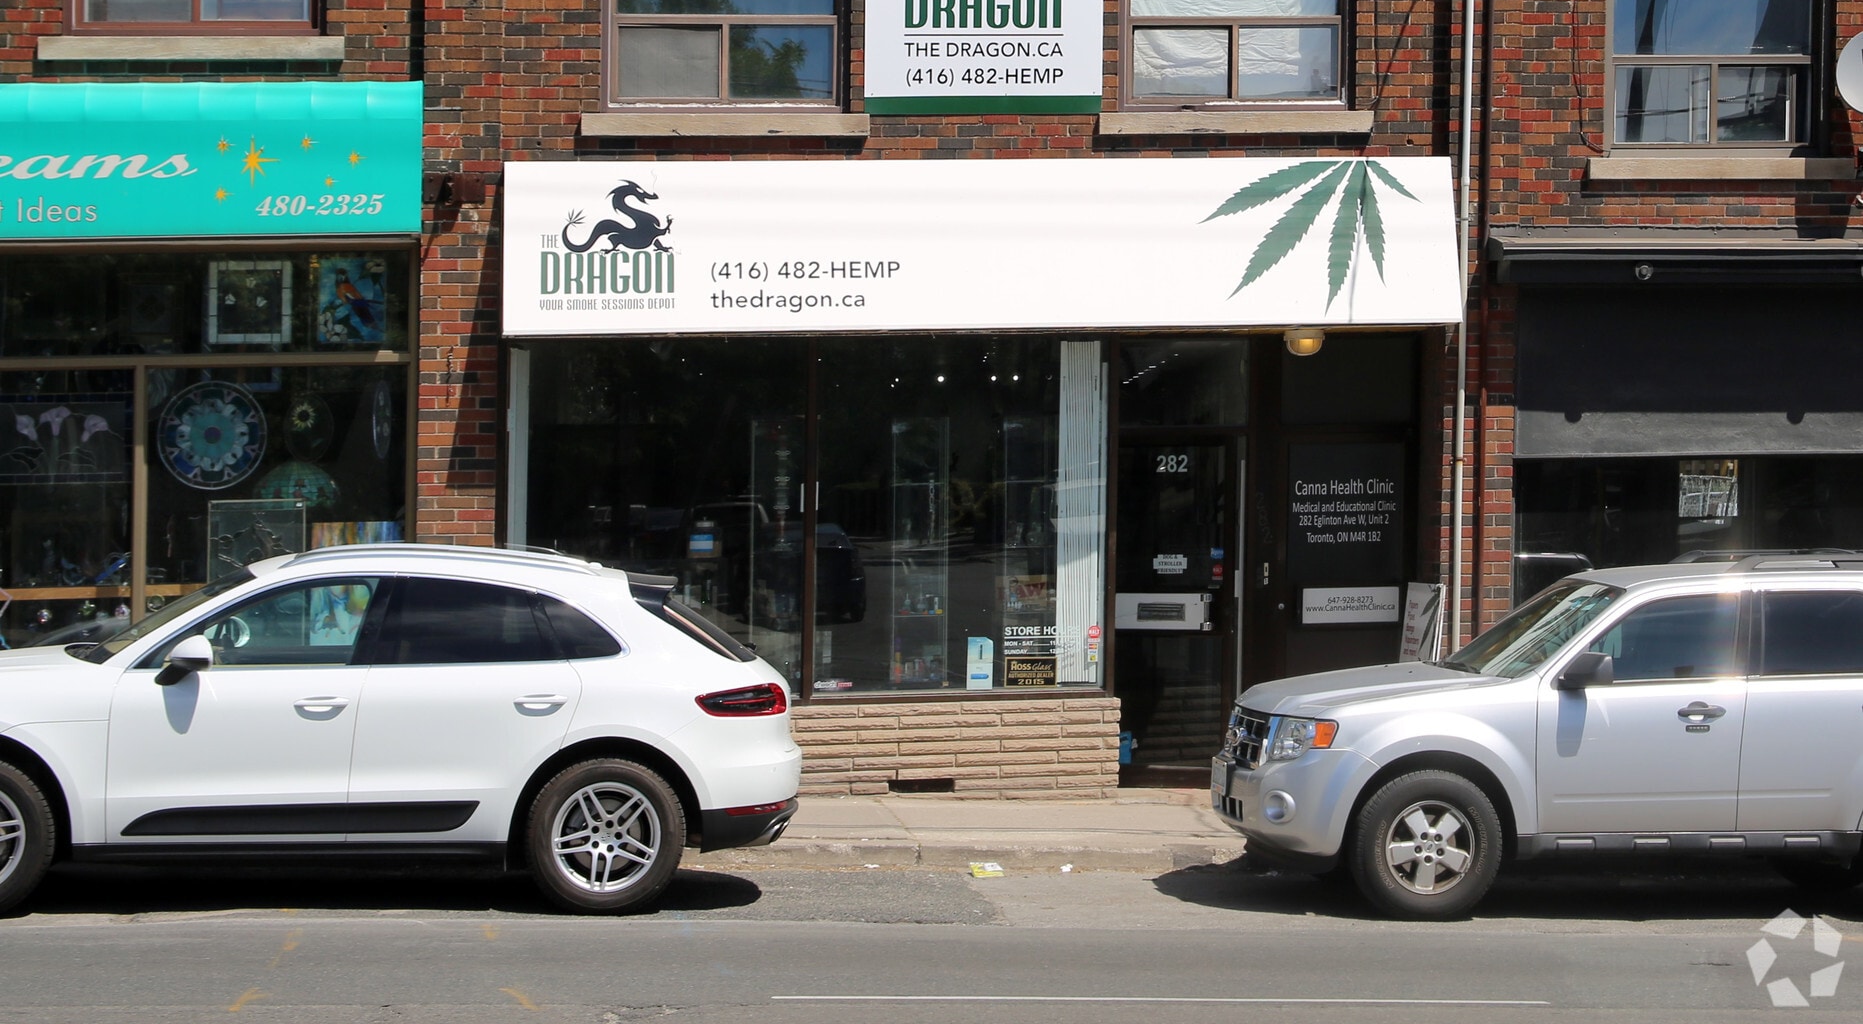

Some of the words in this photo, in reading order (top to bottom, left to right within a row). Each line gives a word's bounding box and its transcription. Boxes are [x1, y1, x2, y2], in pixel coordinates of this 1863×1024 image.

[904, 42, 940, 57] THE
[946, 42, 1064, 58] DRAGON.CA
[905, 68, 955, 87] (416)
[961, 68, 1064, 85] 482-HEMP
[17, 196, 98, 223] Ideas
[255, 193, 385, 217] 480-2325
[541, 234, 559, 249] THE
[540, 251, 675, 295] DRAGON
[711, 262, 769, 282] (416)
[778, 261, 900, 279] 482-HEMP
[539, 299, 563, 311] YOUR
[567, 298, 598, 310] SMOKE
[601, 298, 645, 310] SESSIONS
[648, 298, 675, 309] DEPOT
[710, 289, 866, 313] thedragon.ca
[1156, 455, 1188, 473] 282
[1295, 480, 1327, 495] Canna
[1330, 479, 1364, 495] Health
[1366, 479, 1395, 494] Clinic
[1292, 502, 1320, 513] Medical
[1321, 502, 1335, 513] and
[1336, 501, 1376, 512] Educational
[1378, 501, 1396, 511] Clinic
[1299, 515, 1312, 526] 282
[1313, 515, 1342, 528] Eglinton
[1343, 515, 1357, 525] Ave
[1368, 514, 1383, 525] Unit
[1384, 514, 1389, 524] 2
[1306, 532, 1336, 544] Toronto,
[1337, 531, 1348, 543] ON
[1350, 531, 1366, 542] M4R
[1327, 595, 1374, 604] 647-928-8273
[1305, 603, 1396, 613] www.CannaHealthClinic.ca
[1004, 626, 1041, 636] STORE
